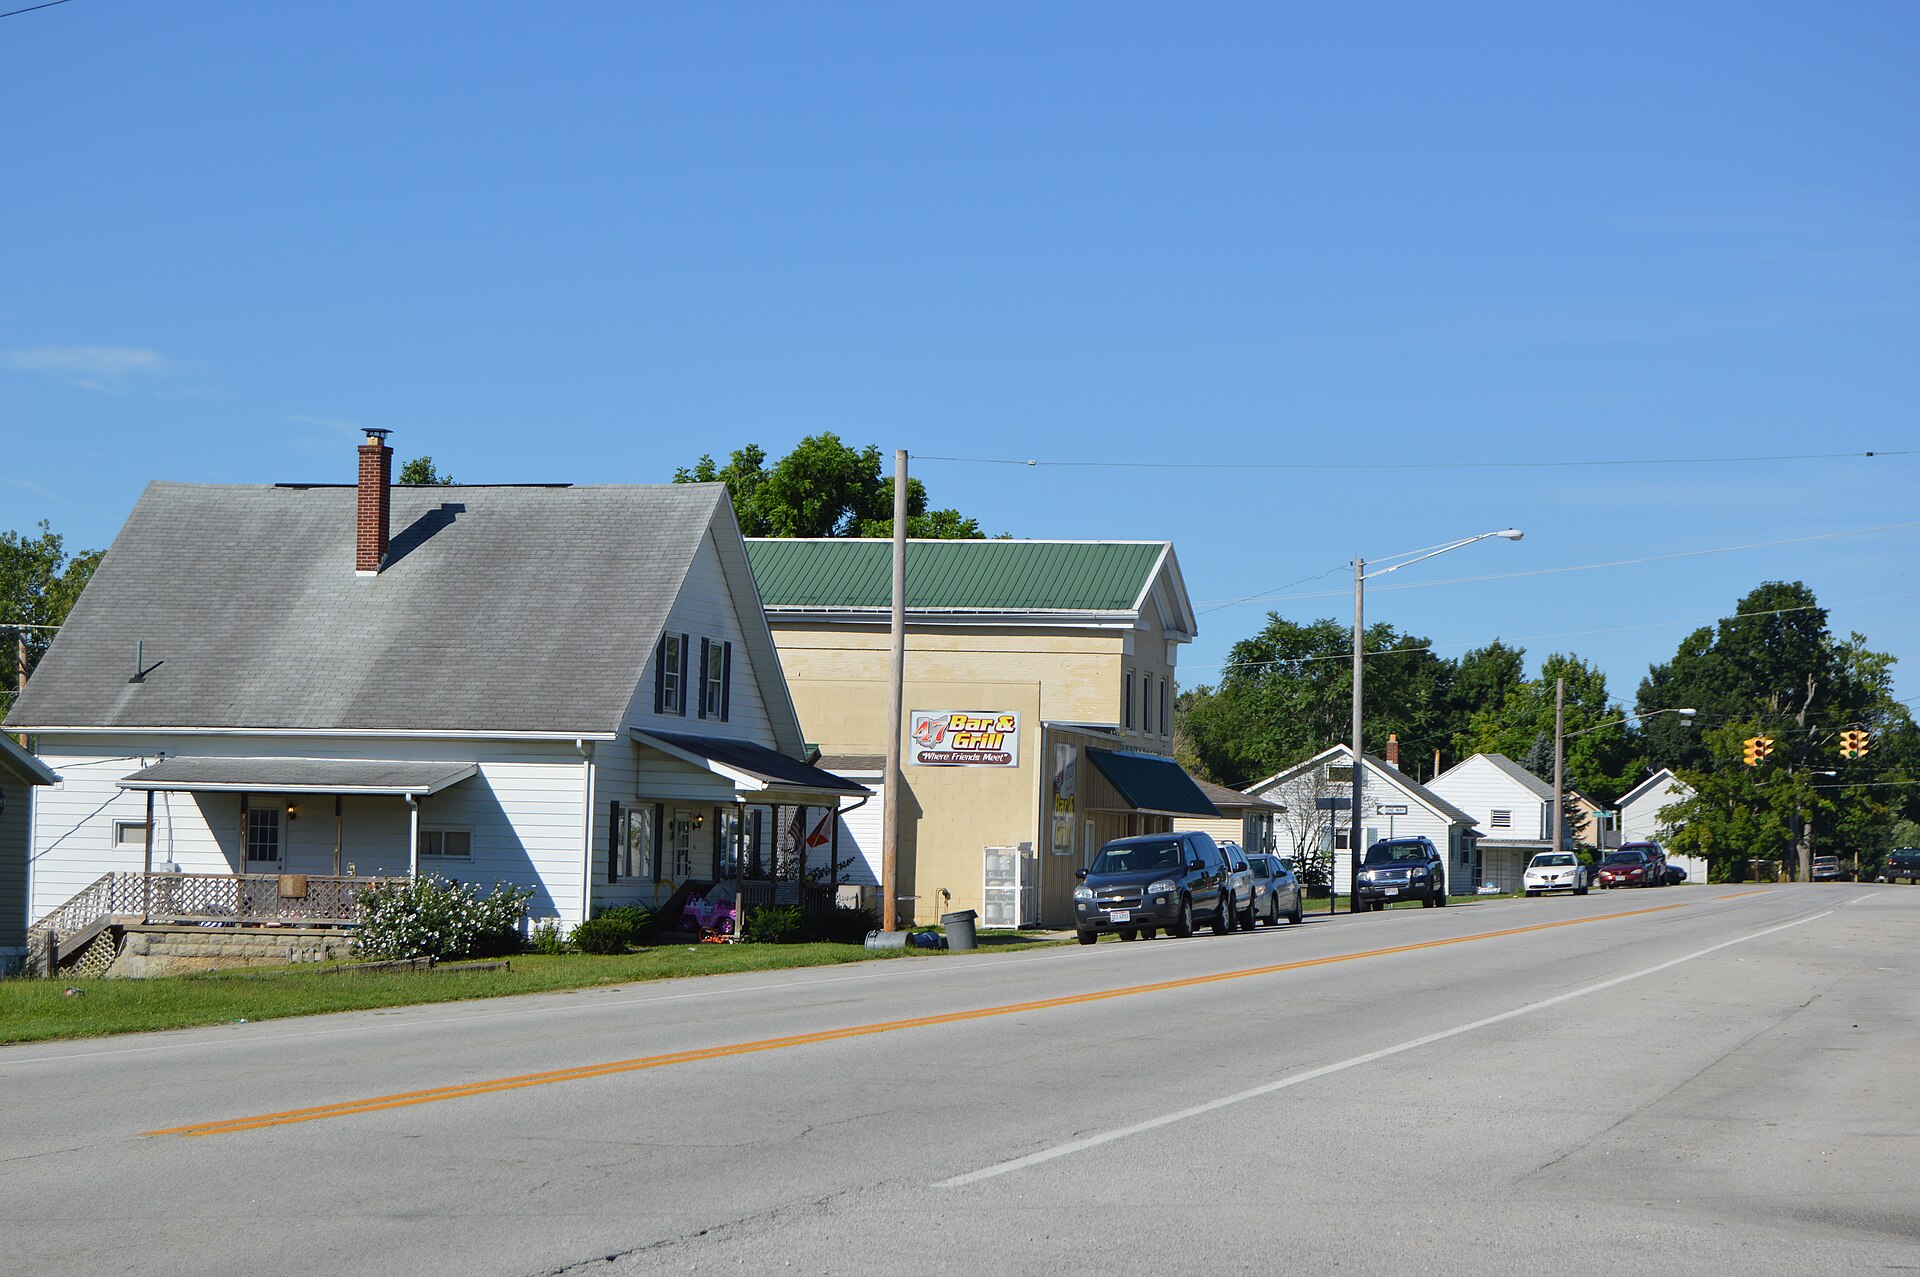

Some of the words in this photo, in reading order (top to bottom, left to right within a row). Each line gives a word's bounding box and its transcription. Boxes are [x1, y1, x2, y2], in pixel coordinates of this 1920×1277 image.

[913, 720, 947, 743] 47
[948, 714, 994, 733] Bar
[995, 715, 1016, 733] &
[952, 732, 1005, 750] Grill
[951, 752, 981, 761] Friends
[1054, 792, 1068, 817] Bar
